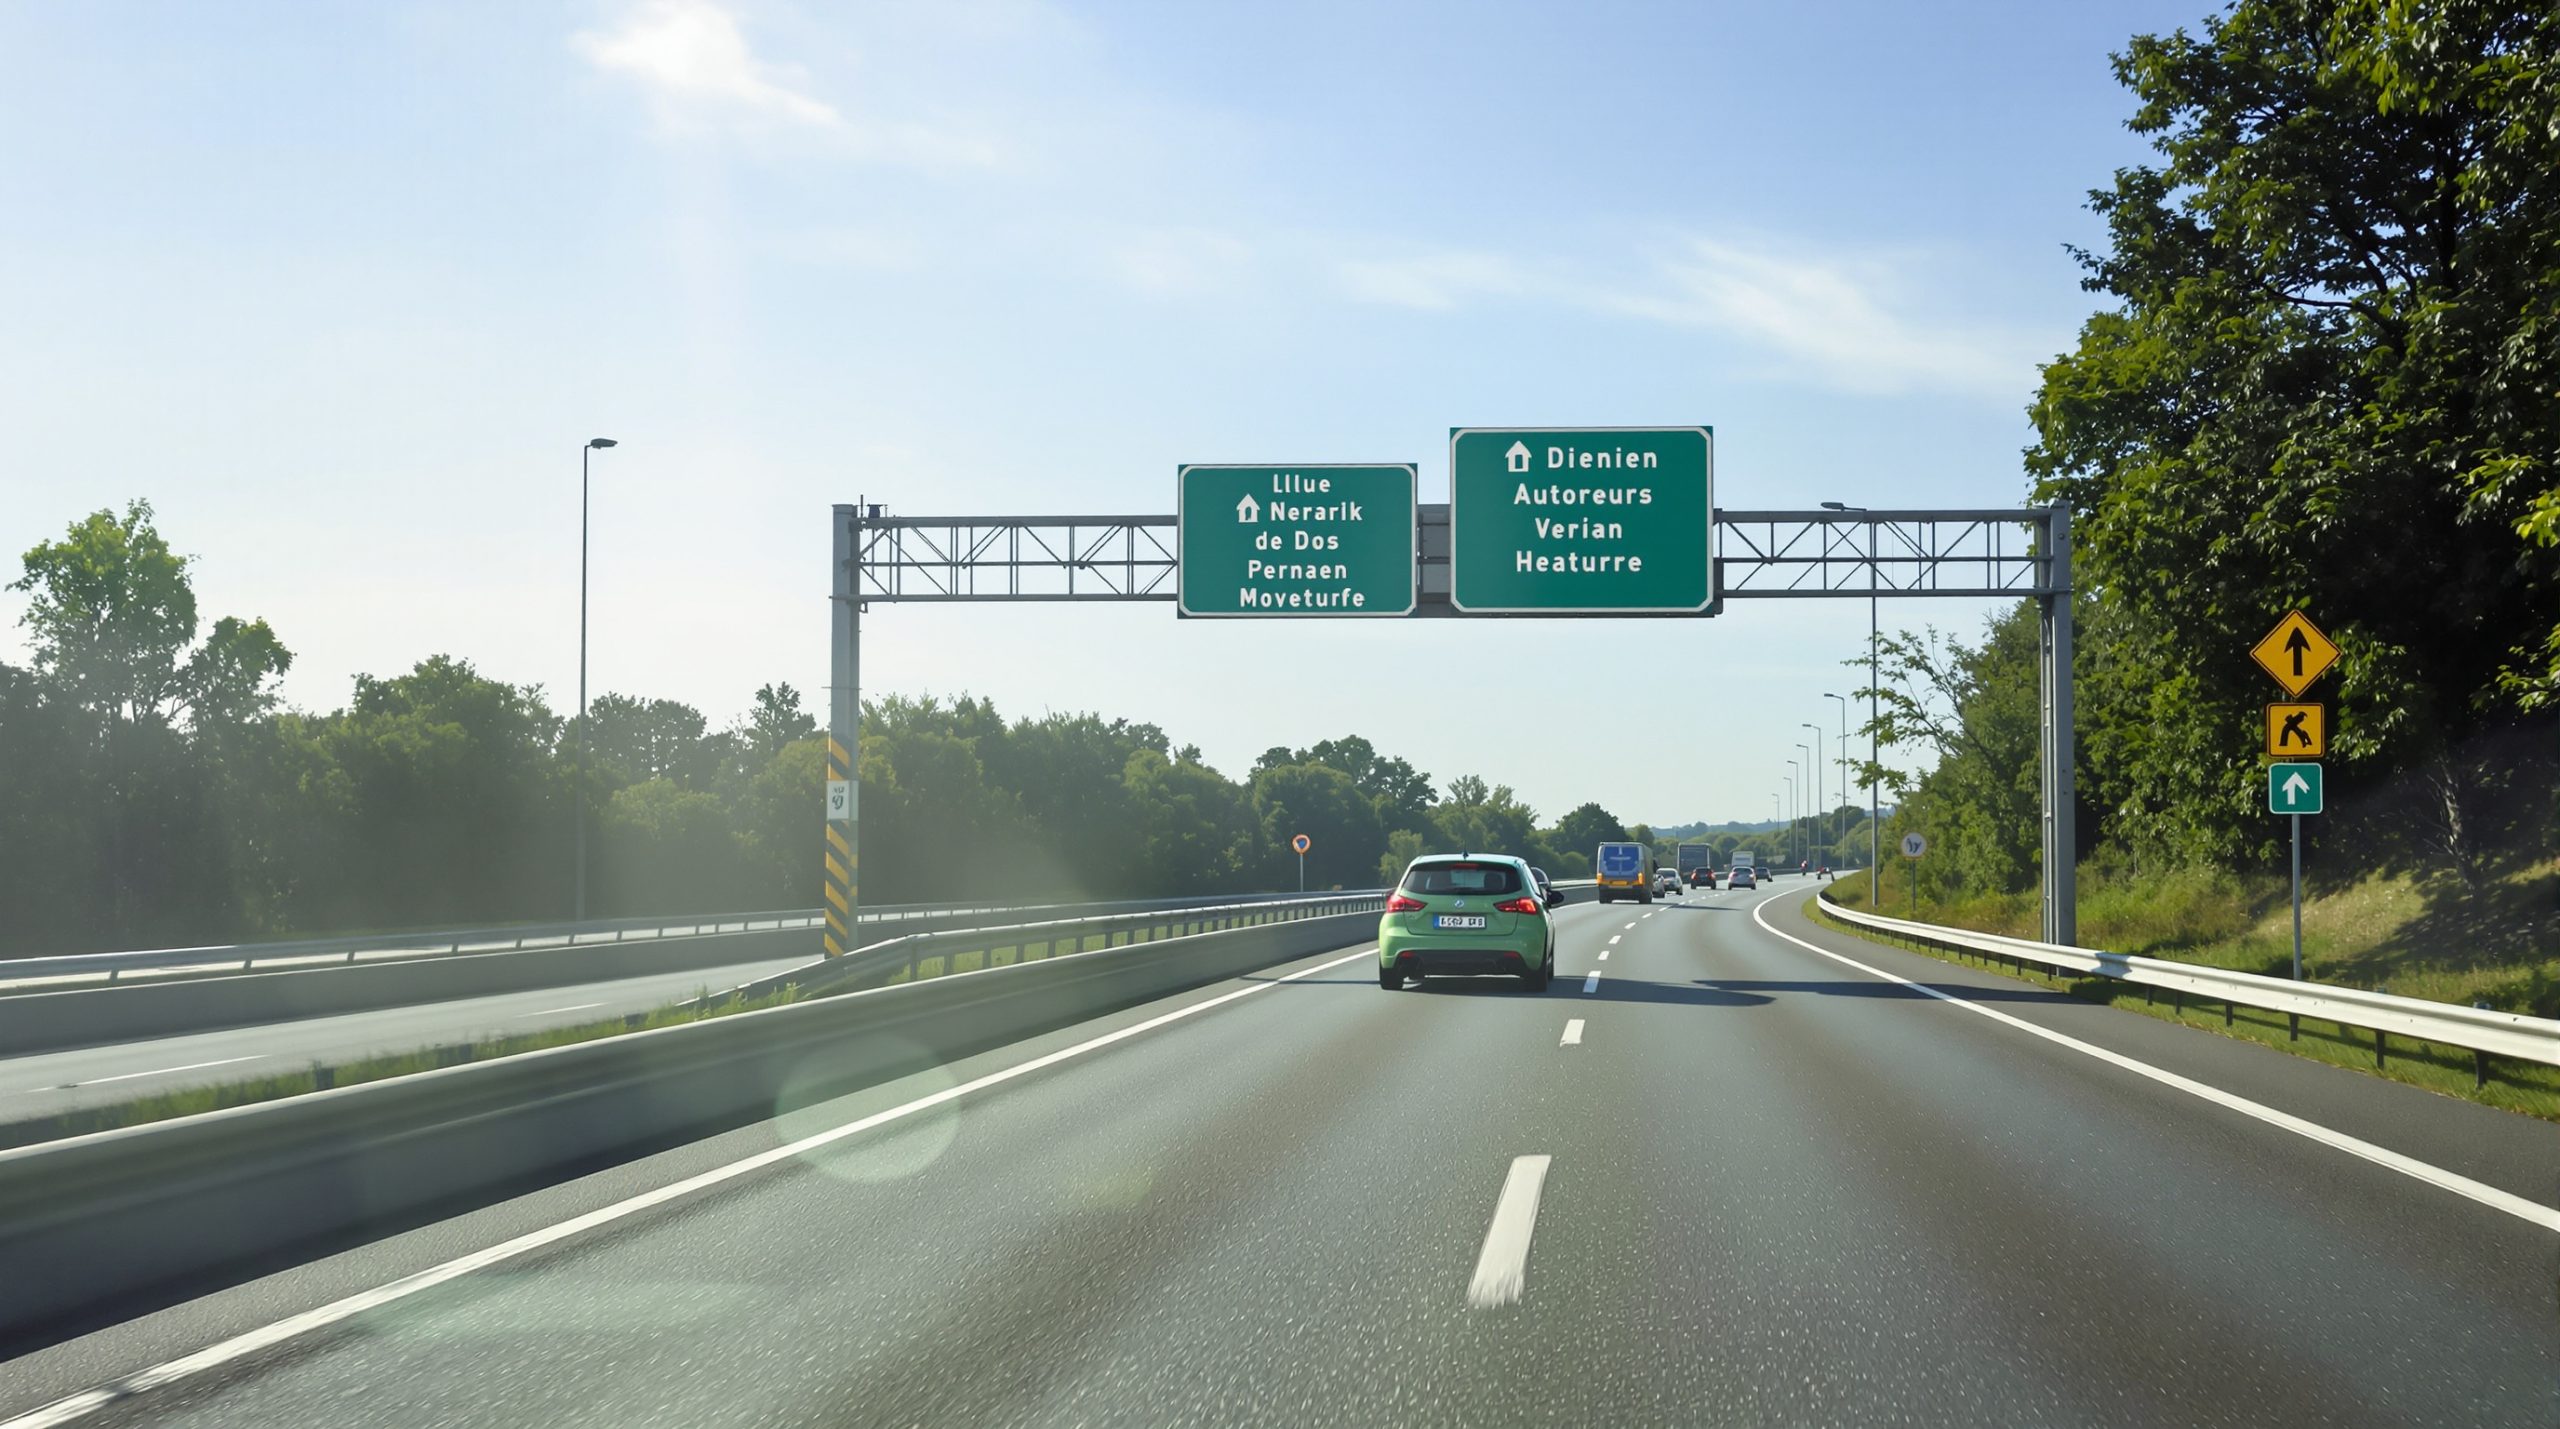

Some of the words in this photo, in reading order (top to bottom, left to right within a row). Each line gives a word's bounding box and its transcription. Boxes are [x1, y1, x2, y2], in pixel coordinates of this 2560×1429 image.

[1547, 446, 1657, 469] Dienien
[1513, 482, 1652, 505] Autoreurs
[1534, 517, 1623, 539] Verian
[1255, 530, 1283, 551] de
[1294, 530, 1339, 551] Dos
[1248, 559, 1347, 580] Pernaen
[1516, 550, 1642, 573] Heaturre
[1239, 587, 1365, 608] Moveturfe
